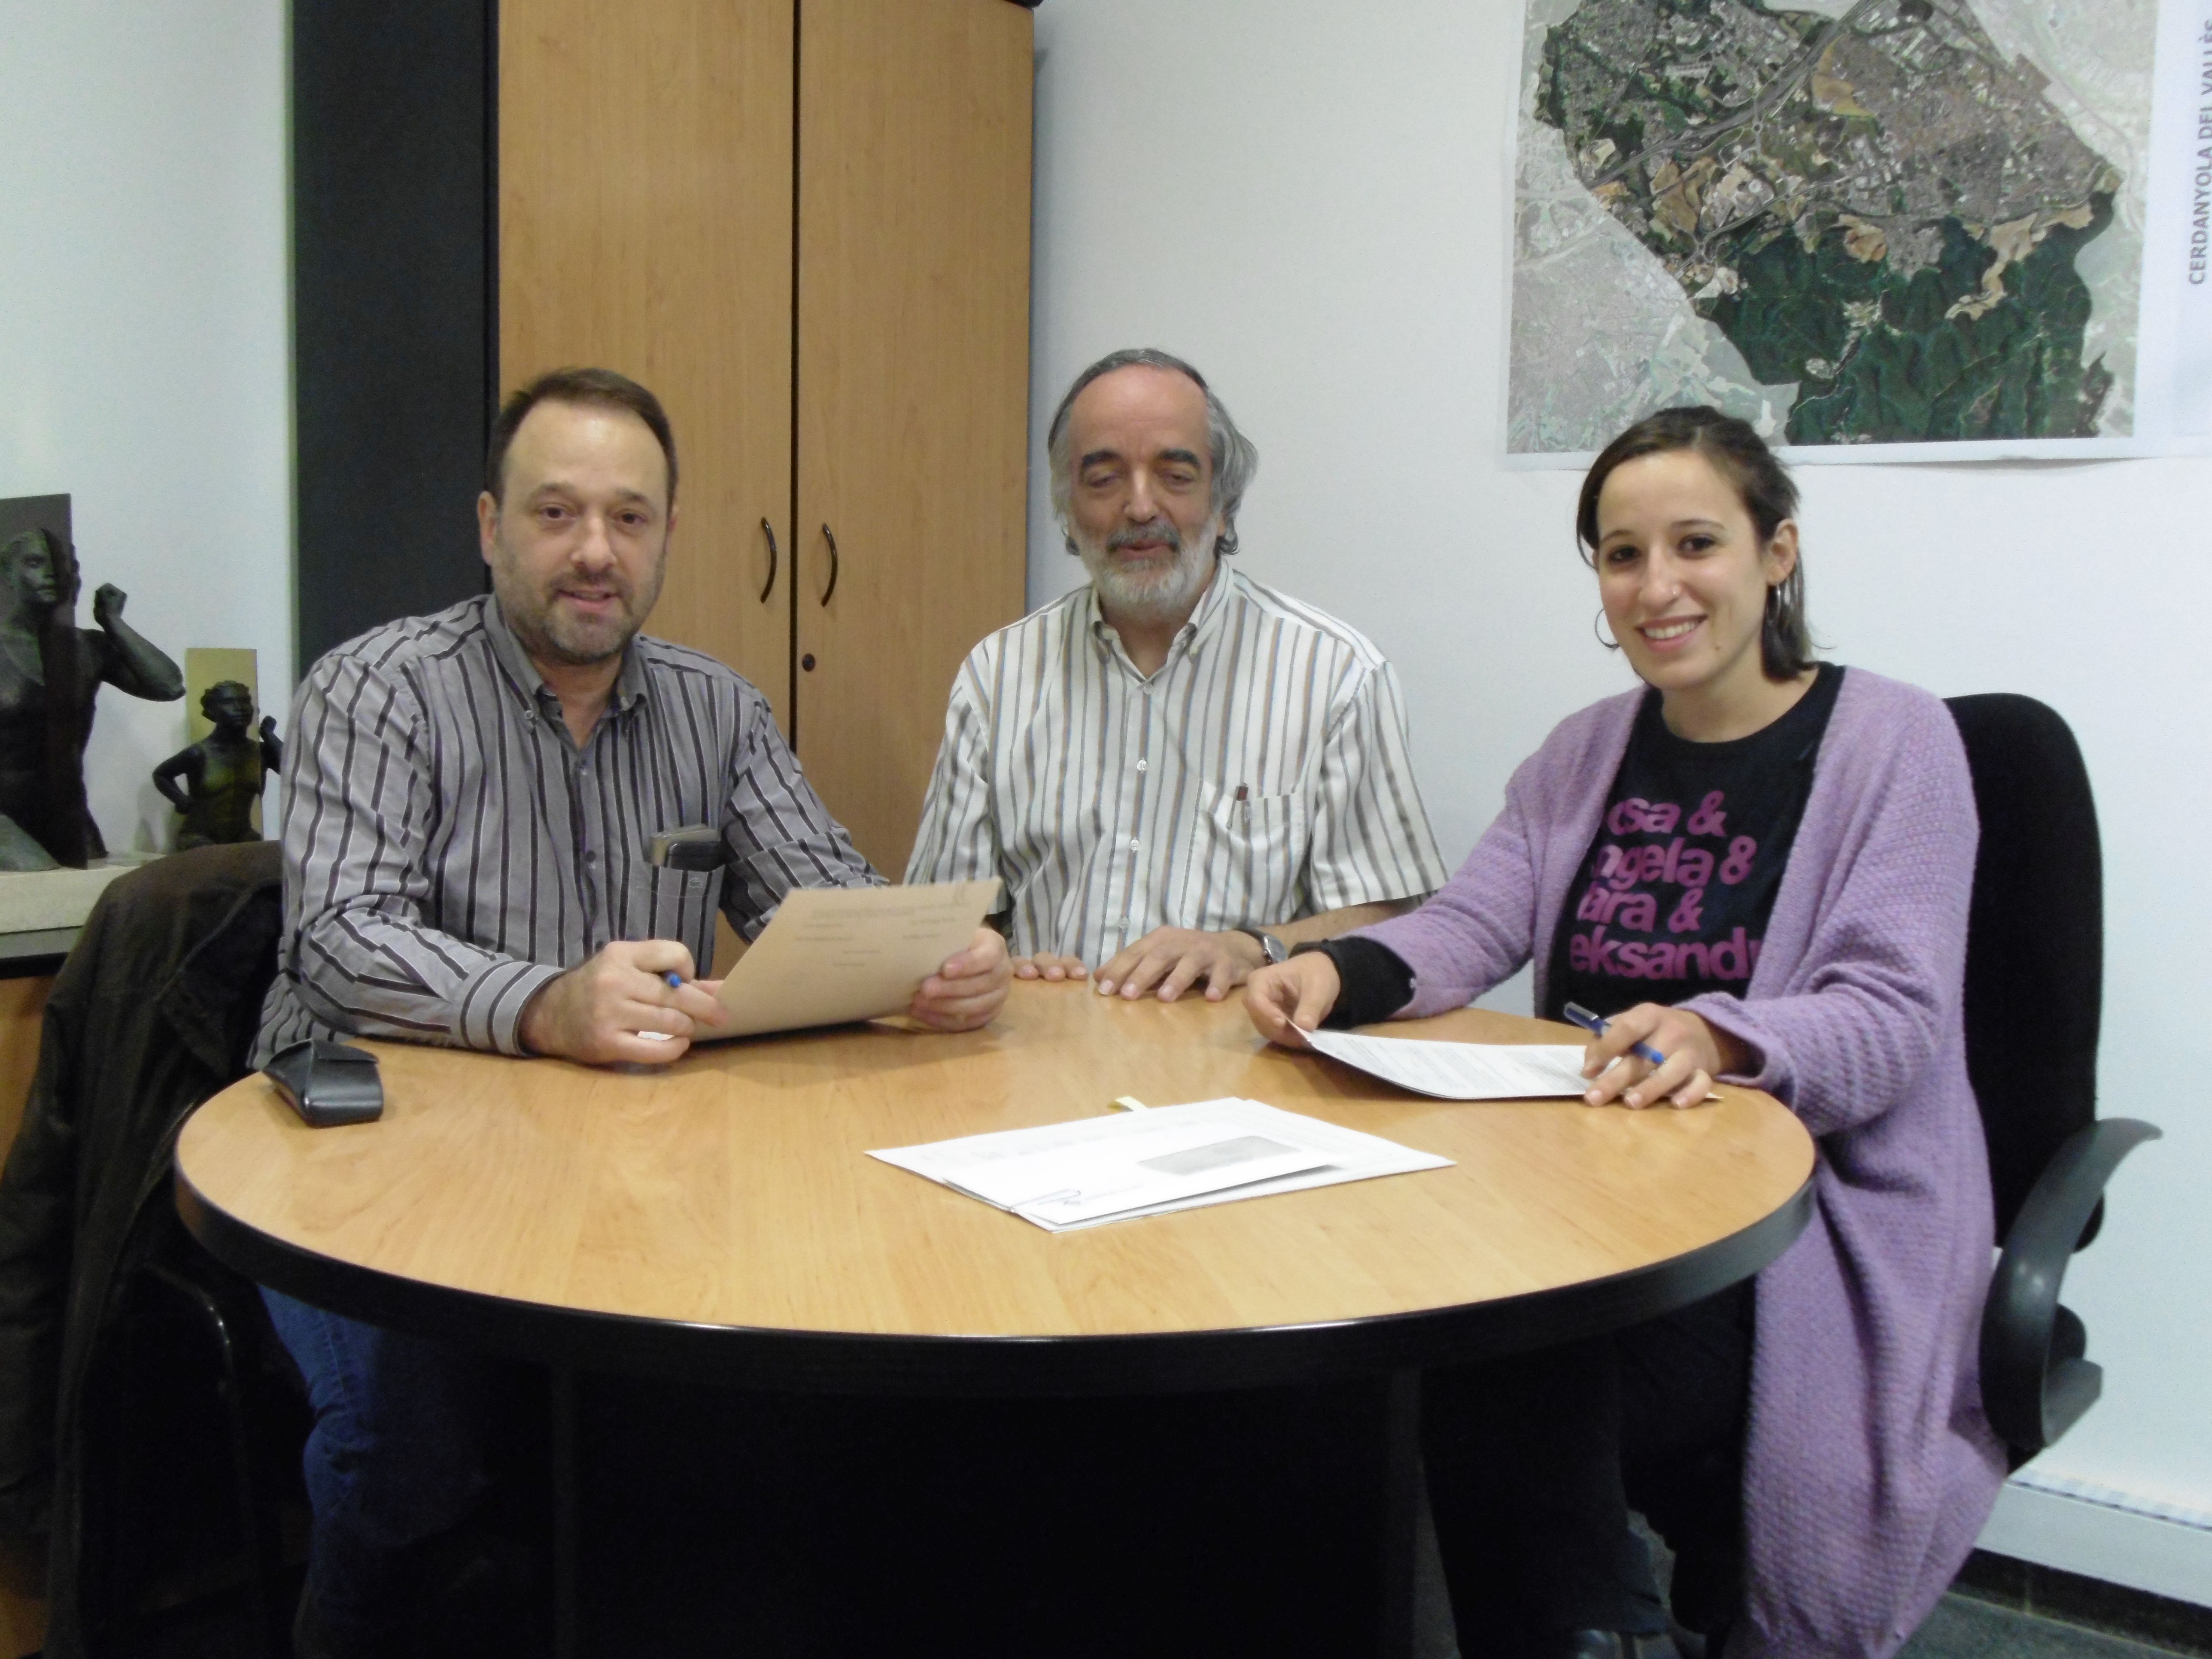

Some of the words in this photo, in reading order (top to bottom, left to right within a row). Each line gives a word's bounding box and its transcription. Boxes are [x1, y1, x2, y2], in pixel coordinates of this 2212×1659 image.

[2189, 147, 2212, 284] CERDANYOLA
[1687, 790, 1726, 837] &
[1668, 888, 1703, 933] &
